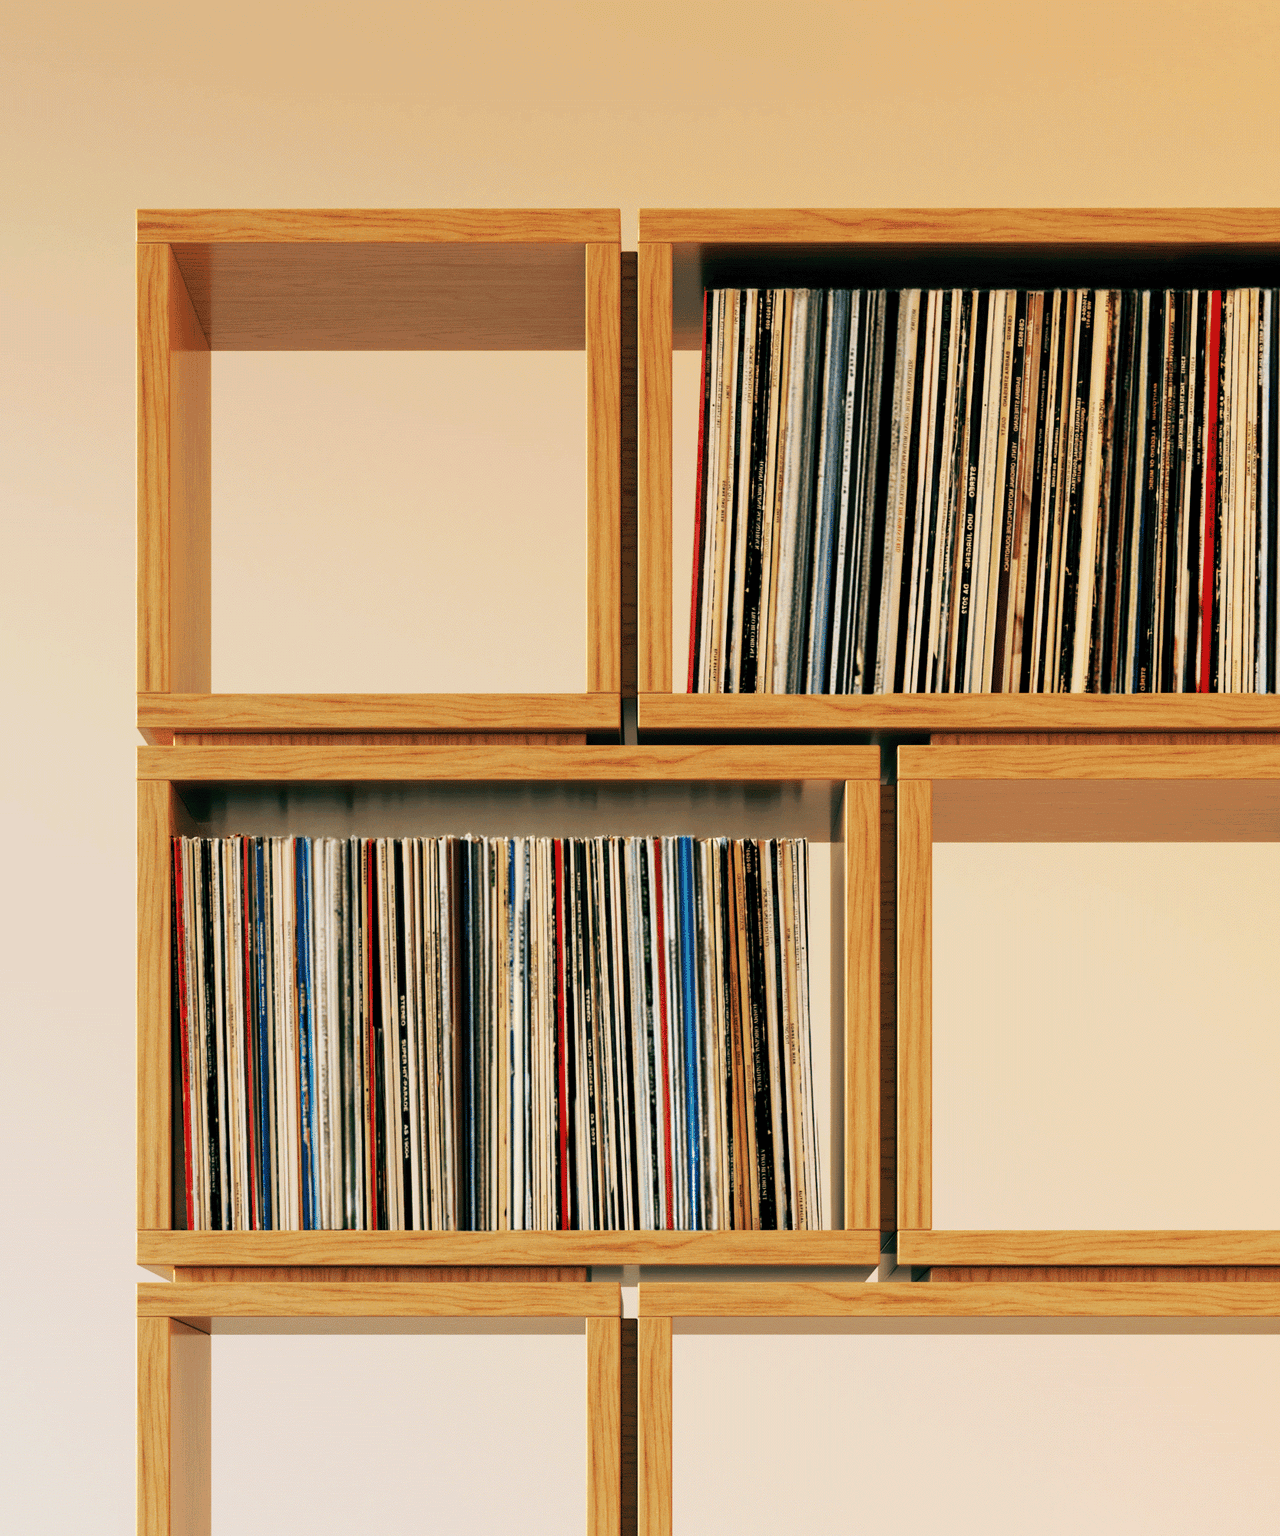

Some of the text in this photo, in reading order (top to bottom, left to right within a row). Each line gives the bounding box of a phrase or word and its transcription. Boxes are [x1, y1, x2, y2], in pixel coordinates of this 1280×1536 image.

[753, 1026, 761, 1052] ORIGINAL
[754, 1053, 763, 1092] SOUNDTRACK
[590, 1113, 596, 1124] DA
[403, 1124, 409, 1135] AS
